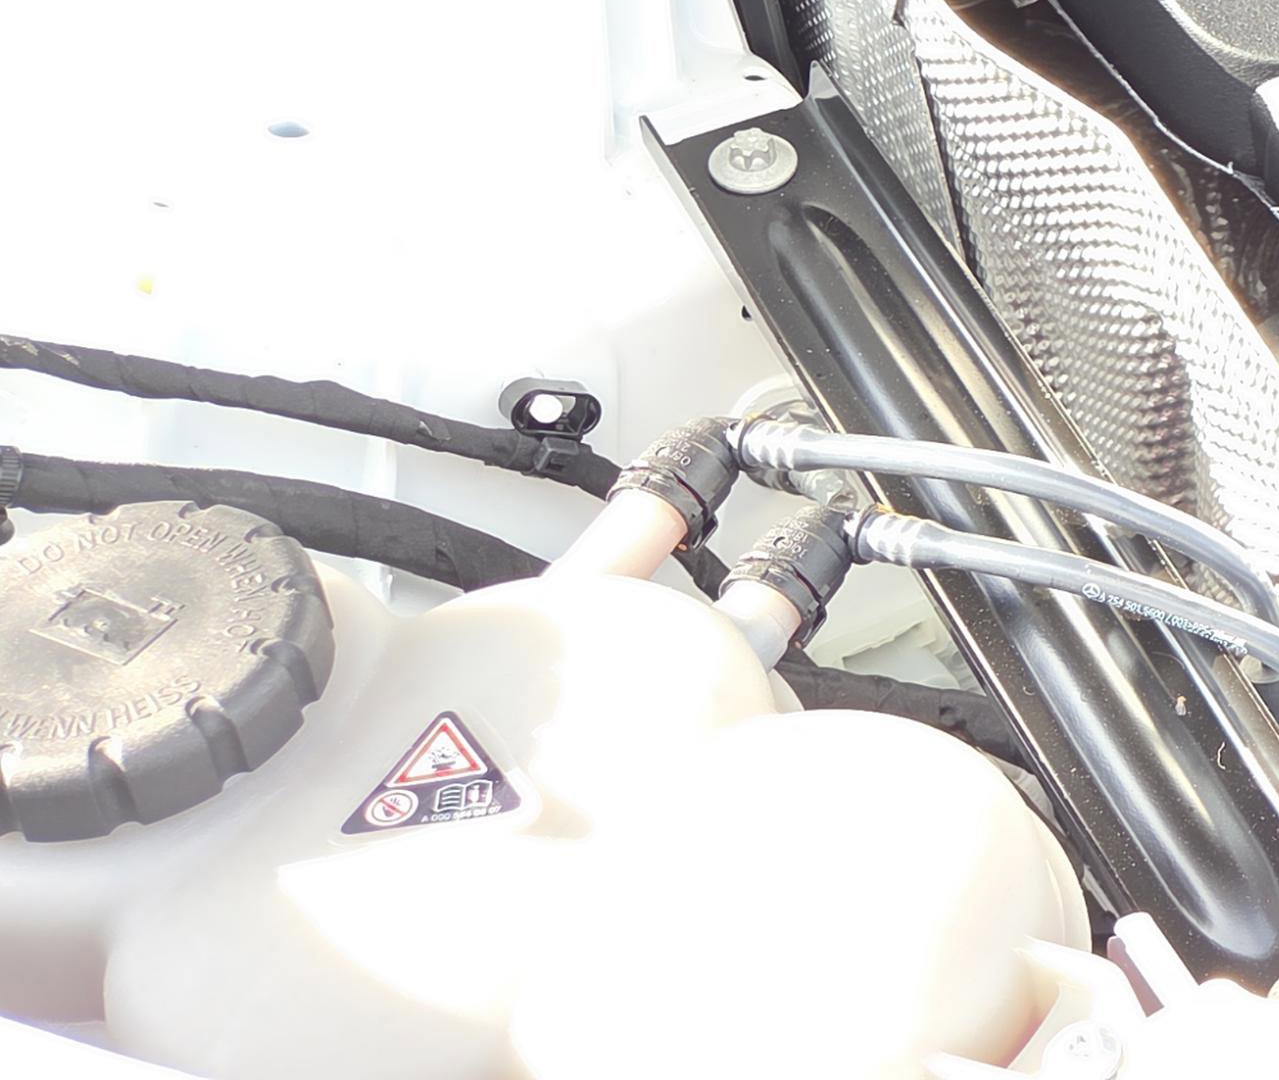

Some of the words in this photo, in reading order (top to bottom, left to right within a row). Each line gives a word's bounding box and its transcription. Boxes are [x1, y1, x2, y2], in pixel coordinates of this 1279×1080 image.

[17, 542, 65, 575] DO
[75, 520, 142, 553] NOT
[150, 521, 229, 553] OPEN
[217, 540, 268, 603] WHEN
[7, 711, 98, 740] WENN
[101, 674, 202, 730] HEISS
[420, 814, 429, 823] A
[431, 812, 452, 822] 000
